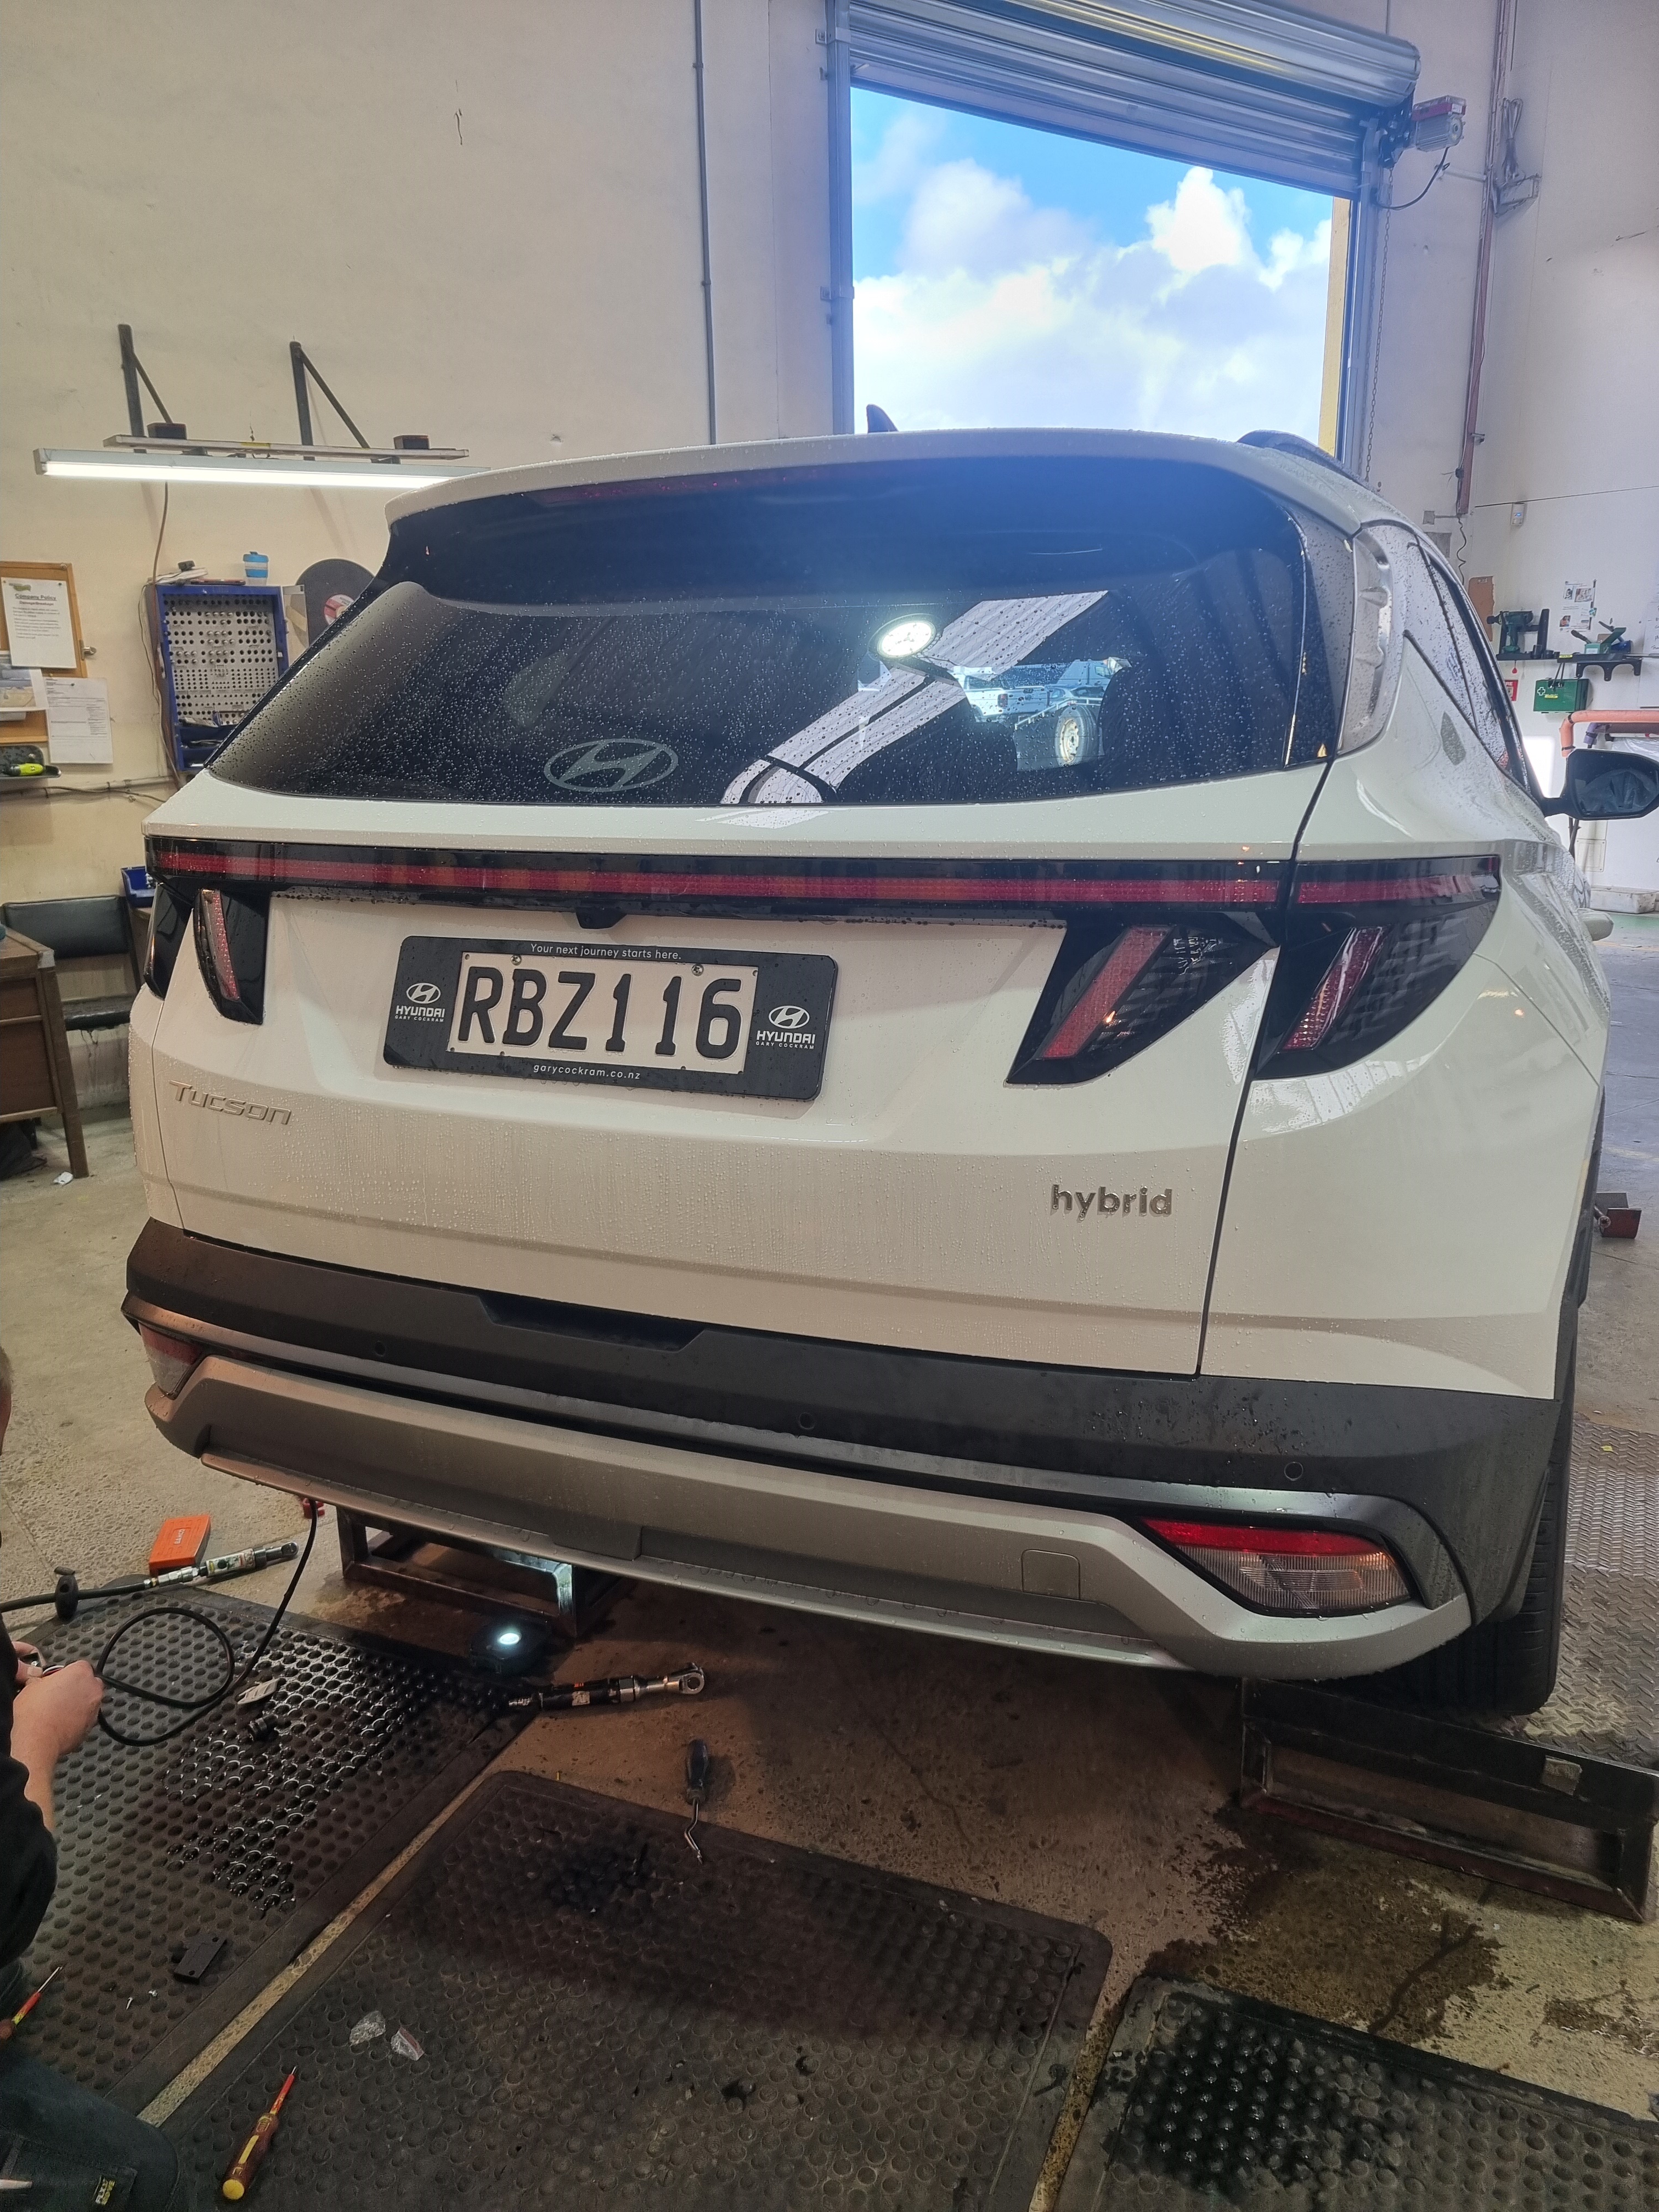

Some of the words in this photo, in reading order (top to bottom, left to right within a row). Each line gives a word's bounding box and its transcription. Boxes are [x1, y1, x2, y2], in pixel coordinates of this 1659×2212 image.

[531, 943, 553, 953] Your
[556, 946, 578, 955] next
[580, 945, 619, 958] journey
[622, 950, 652, 958] starts
[655, 949, 681, 960] here.
[396, 1005, 445, 1018] HYUNDAI
[458, 966, 742, 1059] RBZ116
[757, 1030, 816, 1044] HYUNDAI
[533, 1064, 641, 1079] garycockram.co.nz
[1051, 1184, 1173, 1222] hybrid
